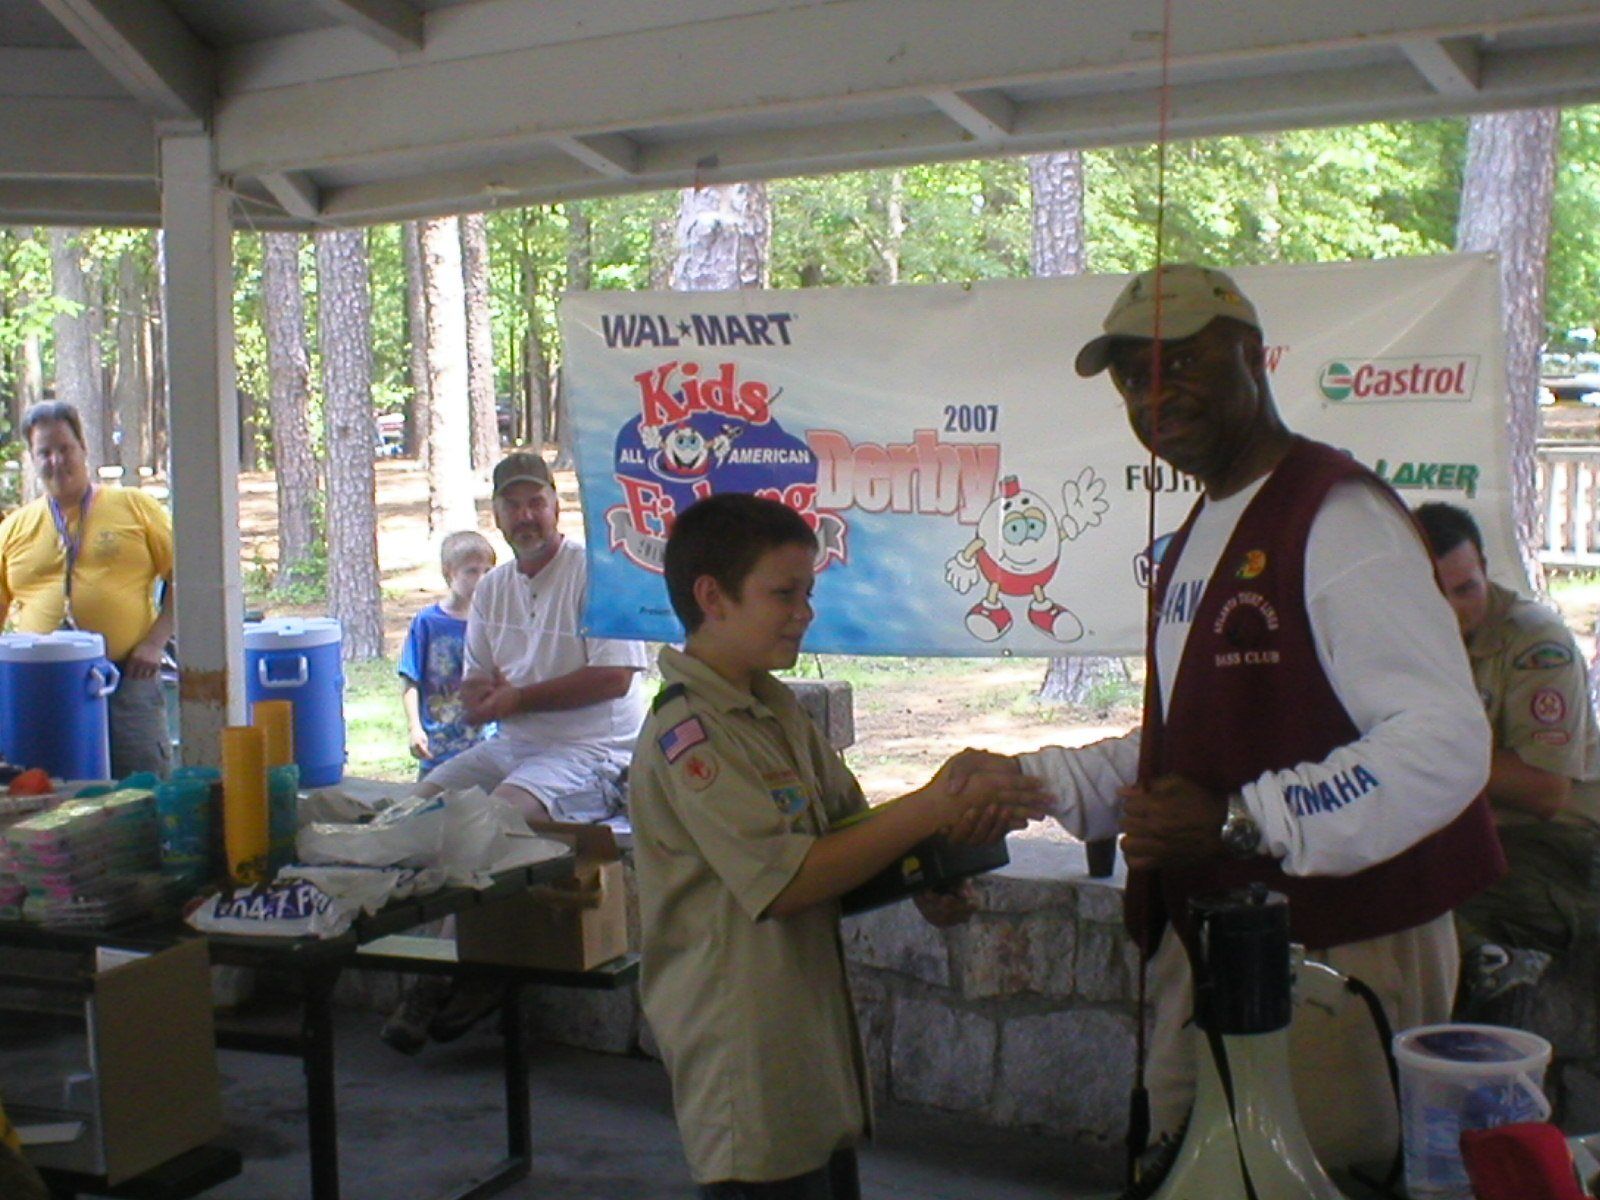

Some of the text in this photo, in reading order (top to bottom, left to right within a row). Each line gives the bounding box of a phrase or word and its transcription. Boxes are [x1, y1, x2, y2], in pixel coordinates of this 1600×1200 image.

[633, 360, 769, 425] Kids
[1353, 361, 1467, 397] Castrol
[943, 404, 999, 432] 2007
[620, 448, 811, 464] ALL AMERICAN
[804, 428, 1001, 526] Derby
[1375, 458, 1481, 499] LAKER
[1244, 650, 1280, 665] CLUB
